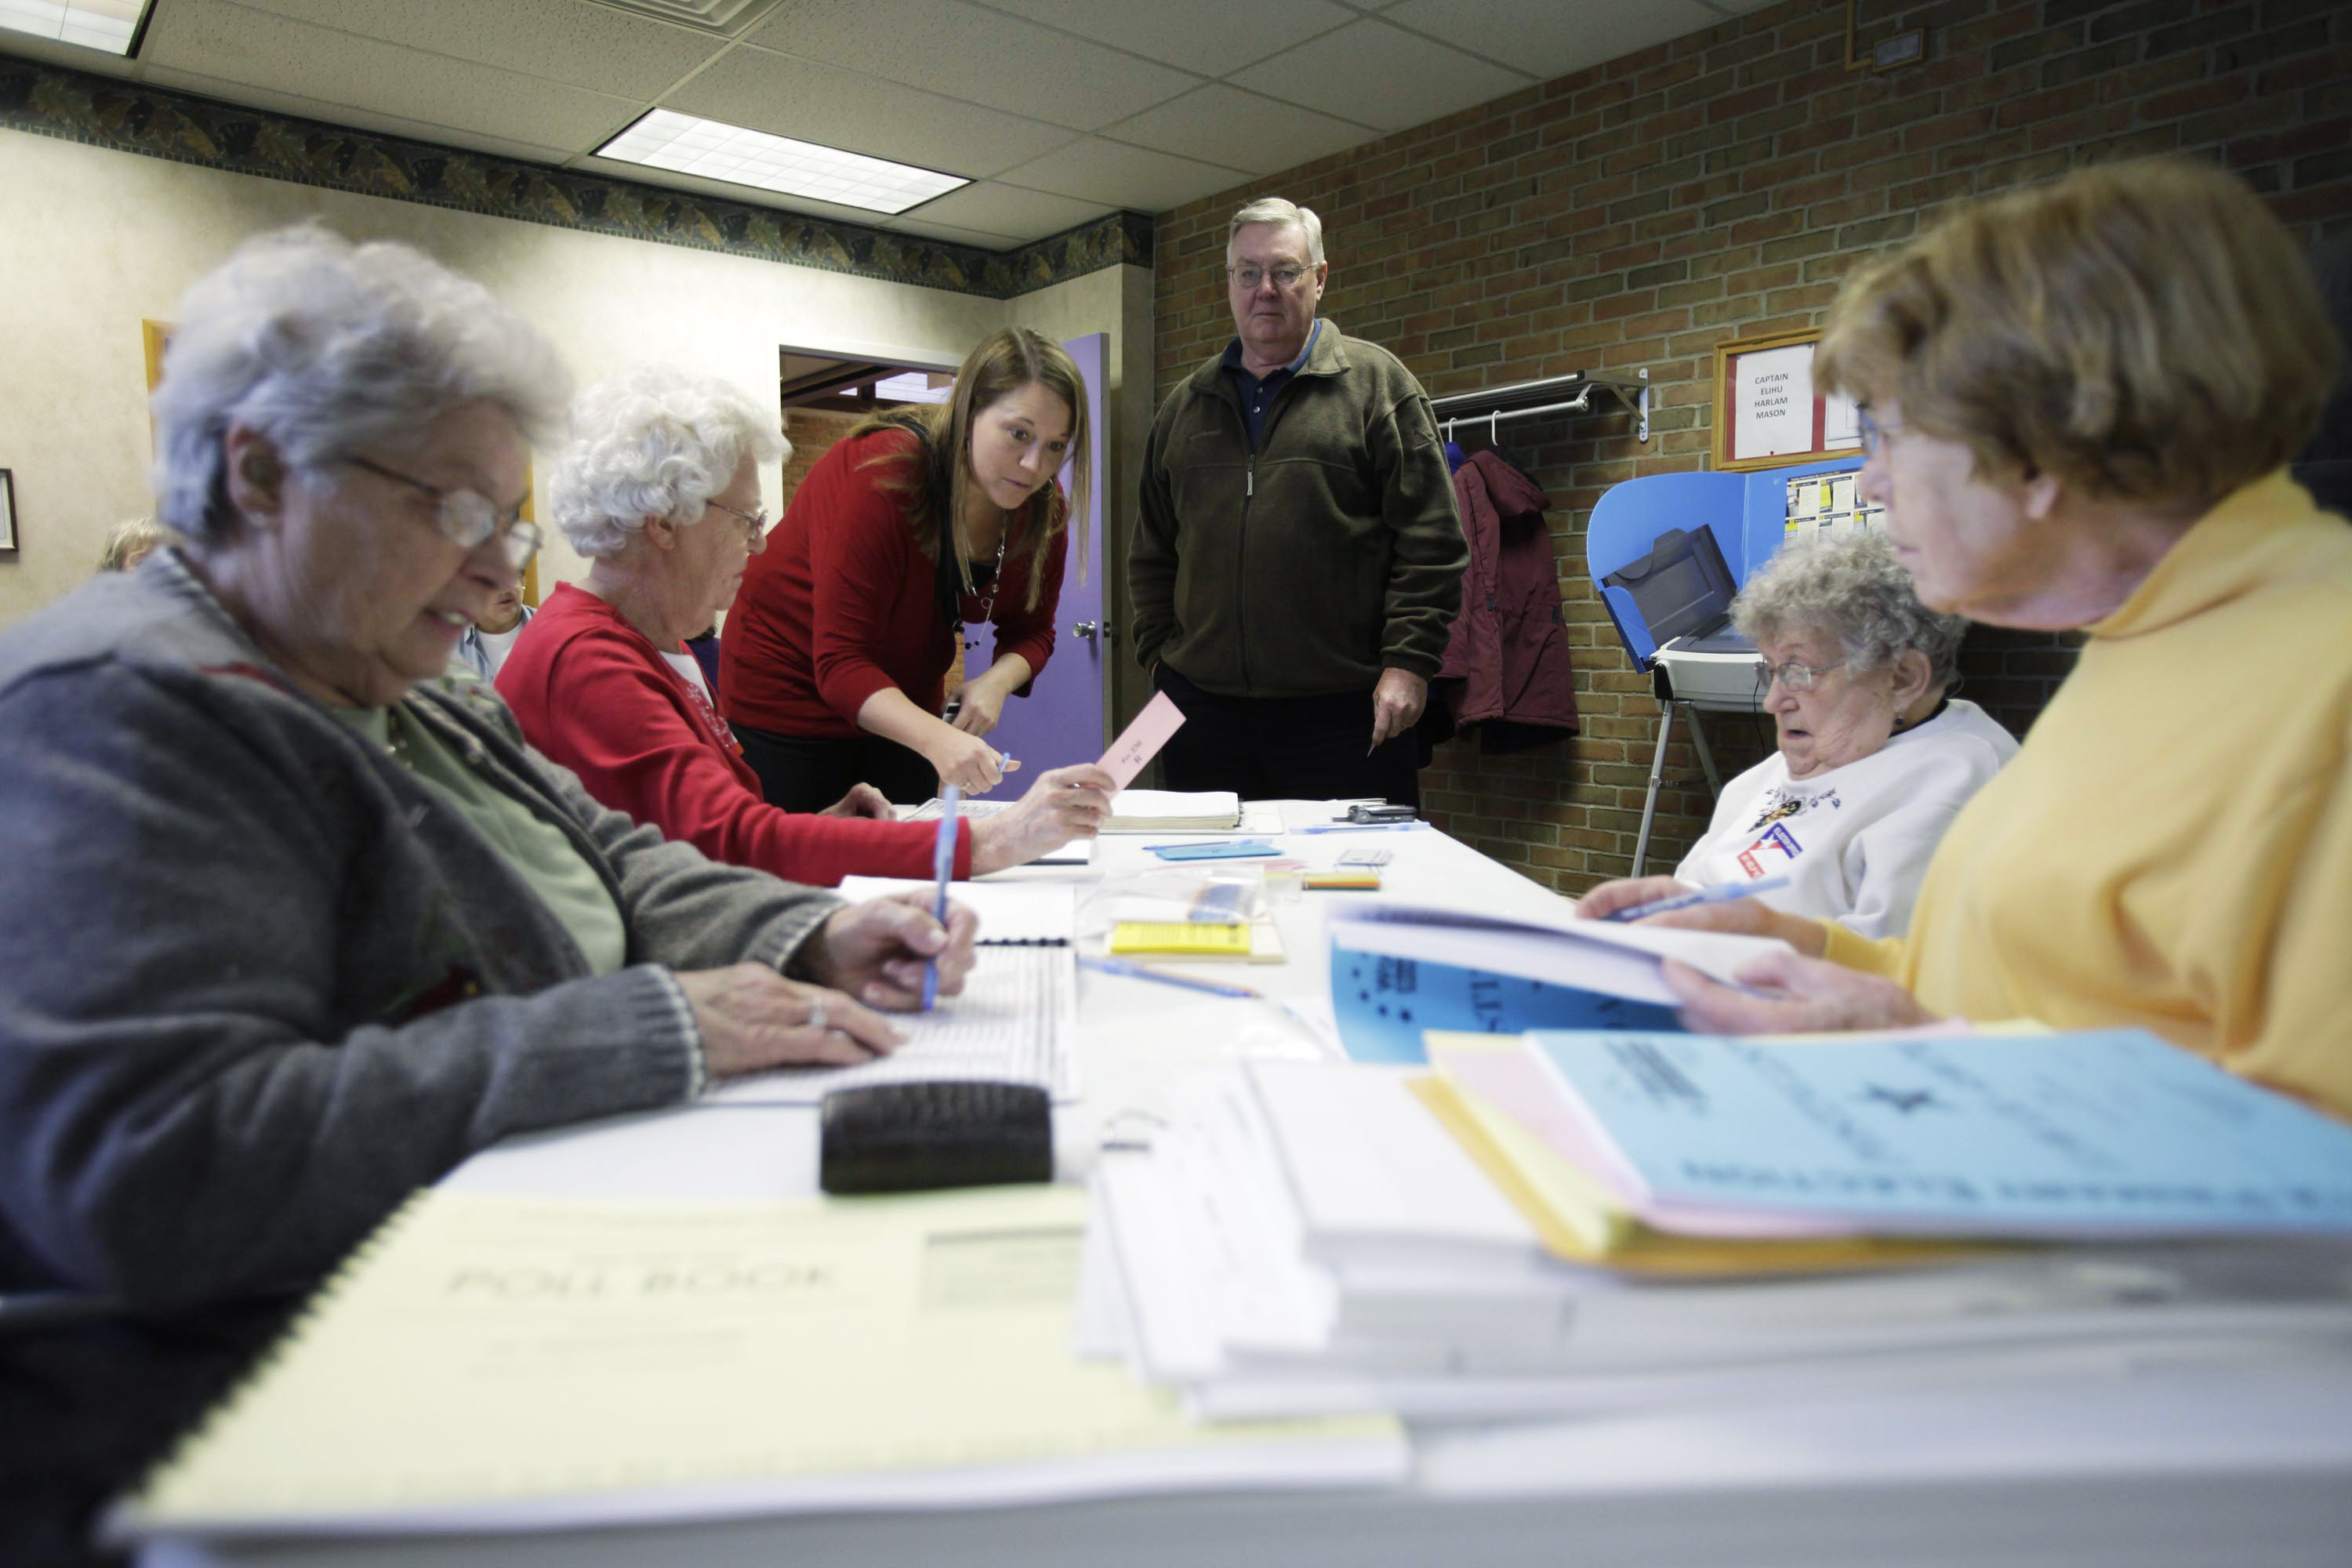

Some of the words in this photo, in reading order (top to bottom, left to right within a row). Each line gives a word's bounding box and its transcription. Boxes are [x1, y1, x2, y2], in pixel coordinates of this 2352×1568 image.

[1755, 373, 1788, 384] CAPTAIN
[1761, 385, 1783, 395] ELIHU
[1755, 397, 1788, 408] HARLAM
[1756, 409, 1786, 419] MASON
[446, 1264, 610, 1300] POLL
[639, 1262, 839, 1297] BOOK
